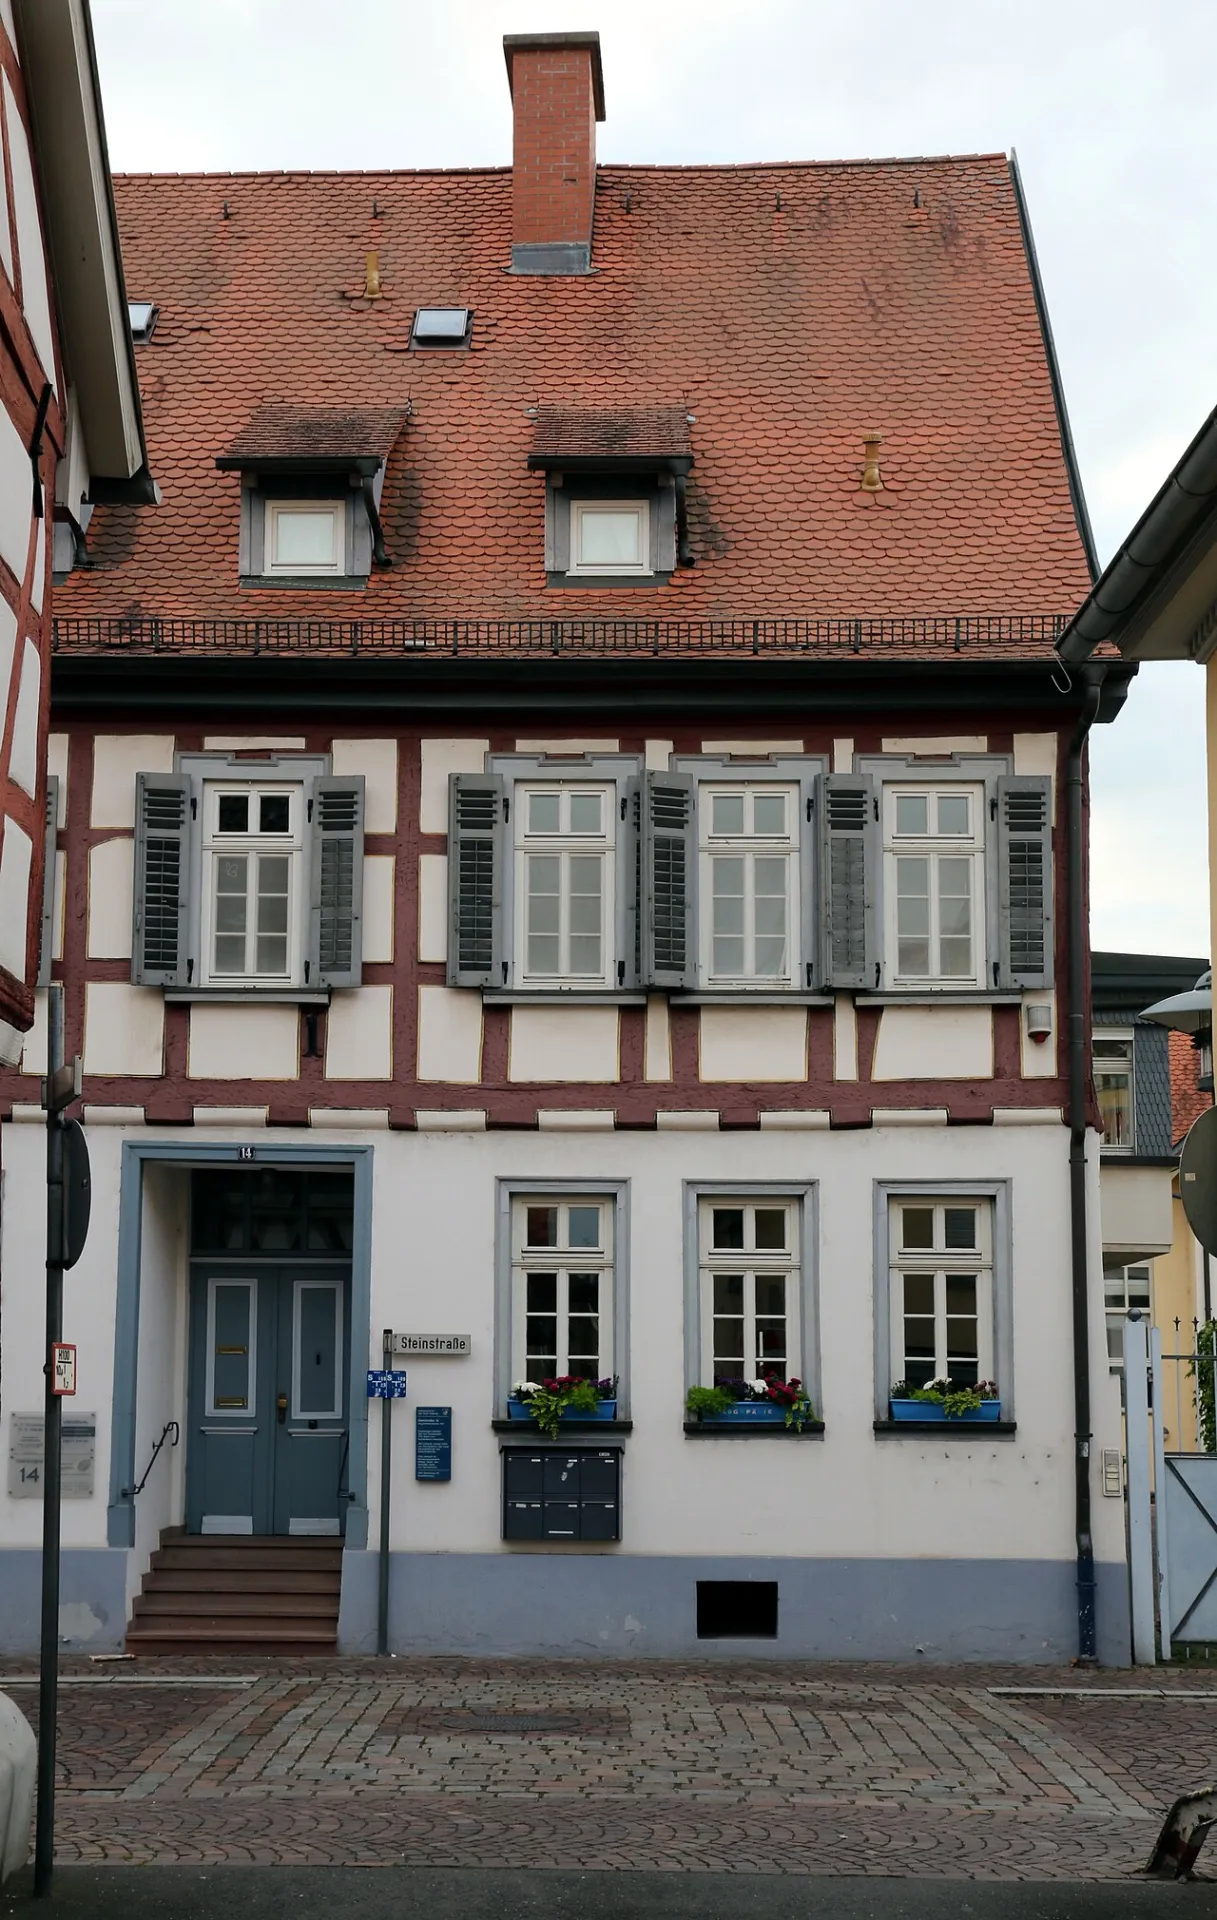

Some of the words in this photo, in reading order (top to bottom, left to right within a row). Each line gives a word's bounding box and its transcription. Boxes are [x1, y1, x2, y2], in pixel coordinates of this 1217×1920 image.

[241, 1147, 252, 1159] 14
[401, 1336, 466, 1350] Steinstraße
[19, 1467, 40, 1483] 14
